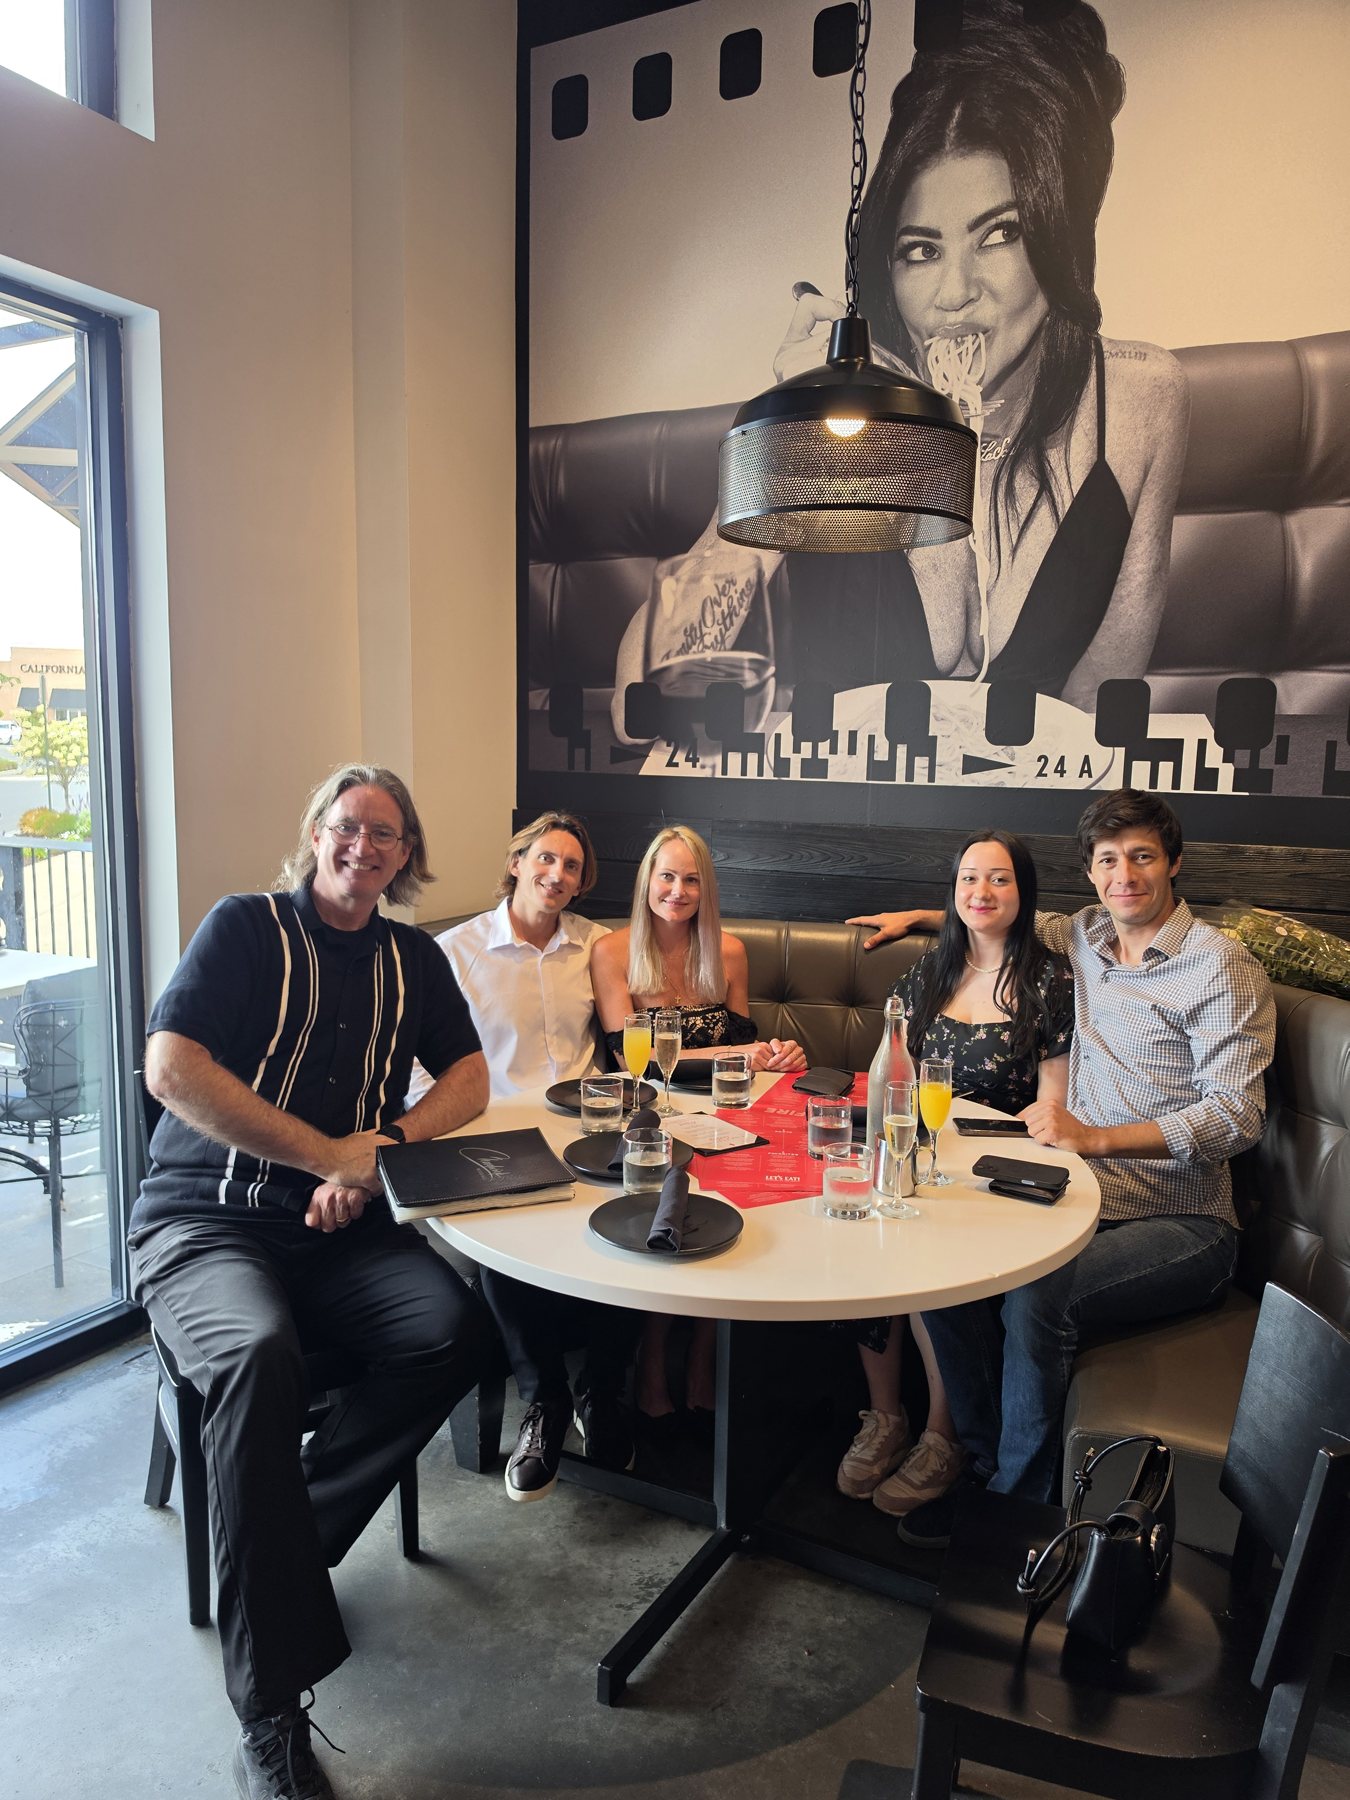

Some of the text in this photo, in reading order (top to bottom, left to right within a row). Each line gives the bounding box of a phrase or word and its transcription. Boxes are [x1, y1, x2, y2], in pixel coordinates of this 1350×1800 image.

[701, 577, 737, 628] Over
[20, 664, 85, 674] CALIFORNIA
[665, 739, 700, 769] 24
[1035, 754, 1093, 779] 24 A
